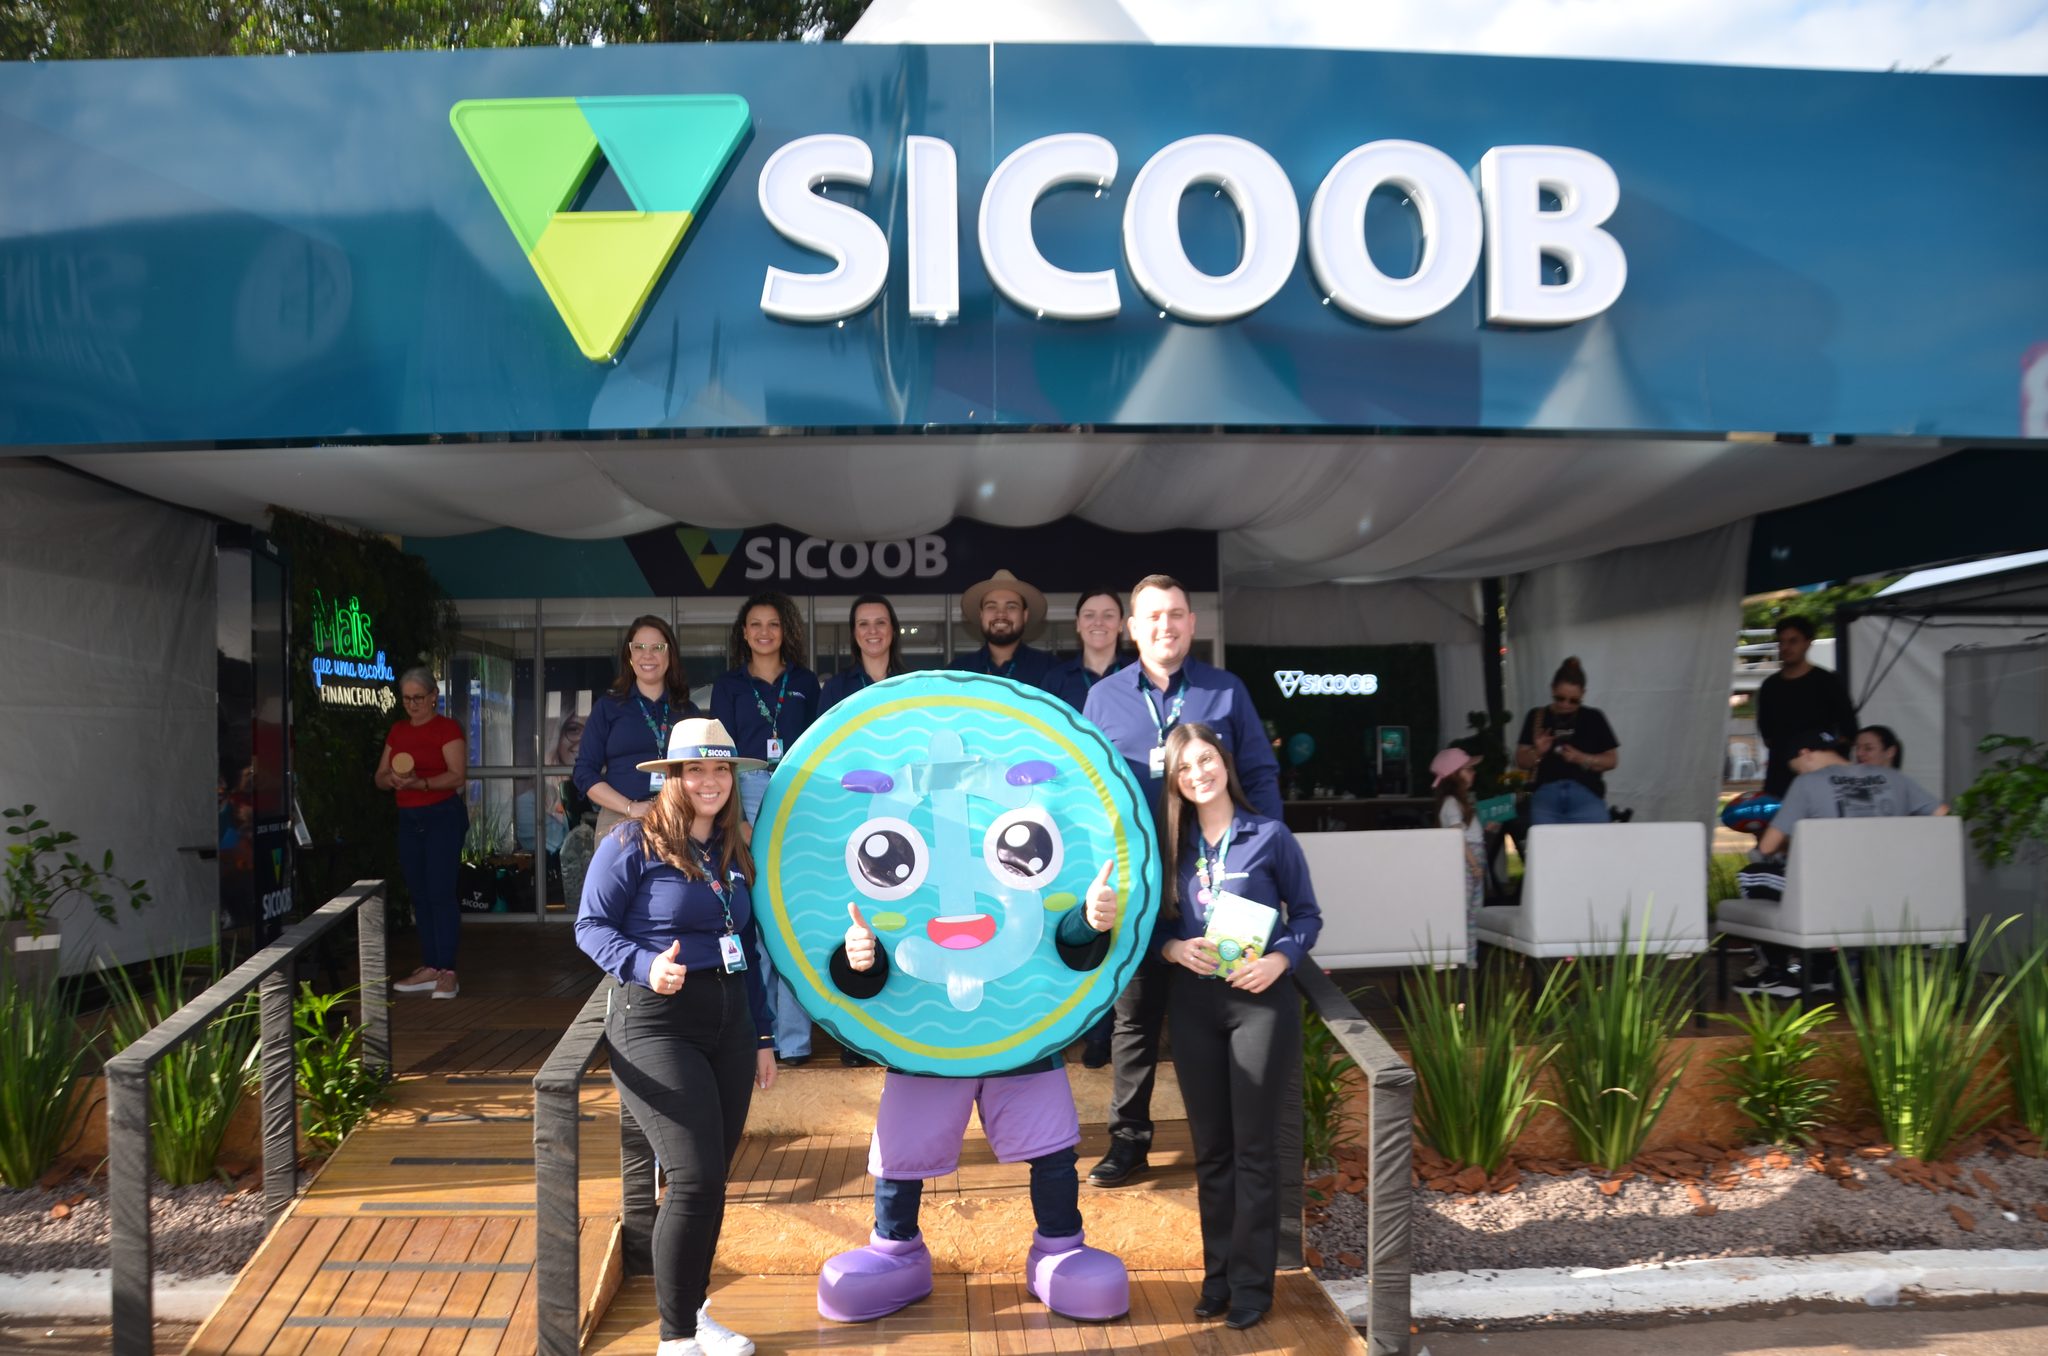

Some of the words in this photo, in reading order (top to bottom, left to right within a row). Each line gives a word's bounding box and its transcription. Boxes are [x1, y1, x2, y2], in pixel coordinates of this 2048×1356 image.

[757, 131, 1629, 327] SICOOB
[744, 534, 949, 580] SICOOB
[313, 588, 374, 659] Mais
[312, 657, 333, 688] que
[333, 660, 357, 678] uma
[357, 650, 395, 681] escolha
[1299, 673, 1378, 695] SICOOB
[707, 749, 731, 757] SICOOB
